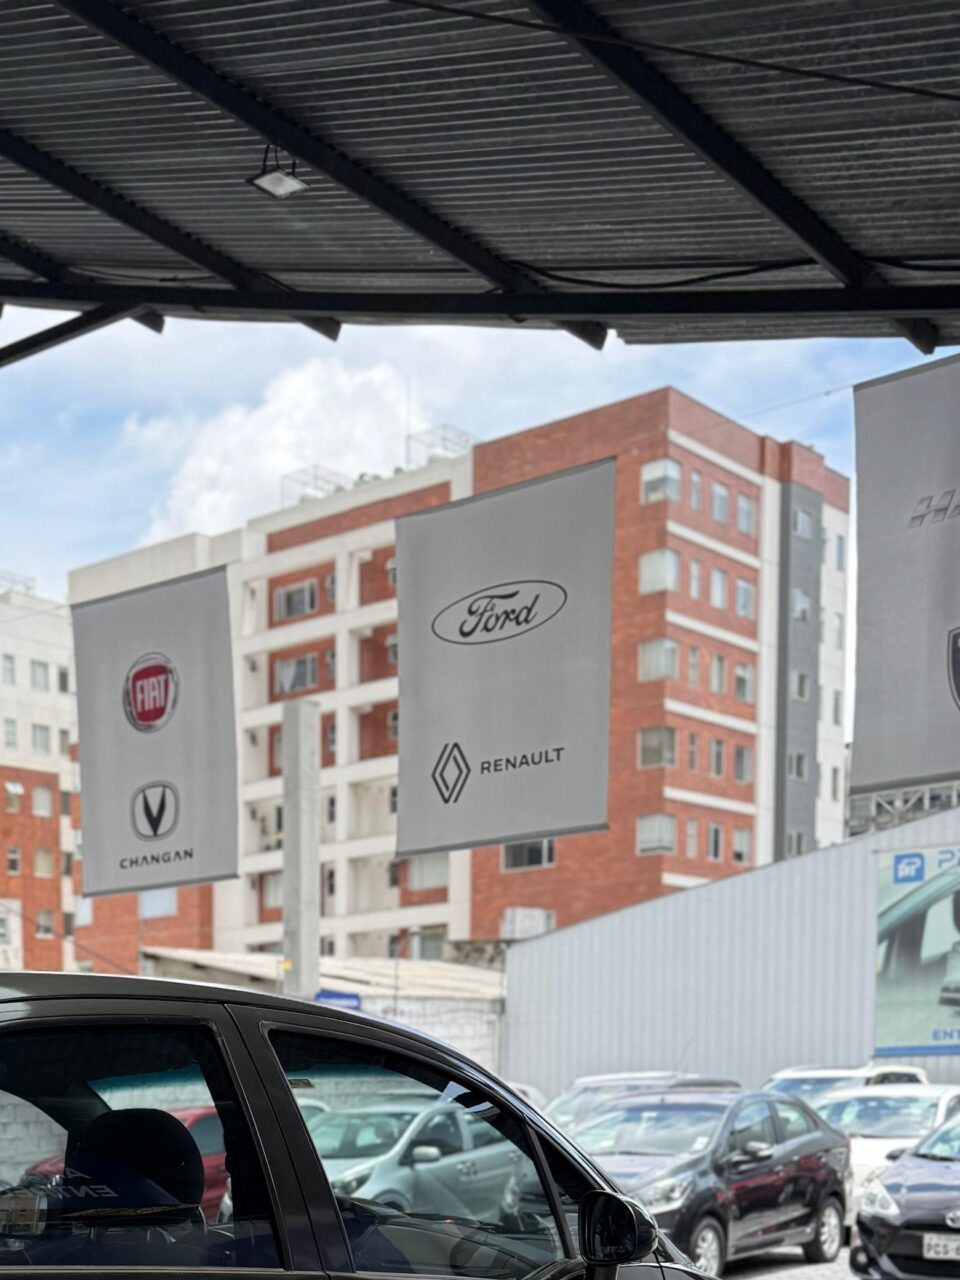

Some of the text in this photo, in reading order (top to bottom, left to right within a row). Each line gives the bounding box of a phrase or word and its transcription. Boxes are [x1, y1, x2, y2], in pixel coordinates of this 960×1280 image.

[458, 590, 540, 638] Ford
[135, 673, 169, 714] FIAT
[480, 747, 565, 775] RENAULT
[120, 848, 194, 869] CHANGAN
